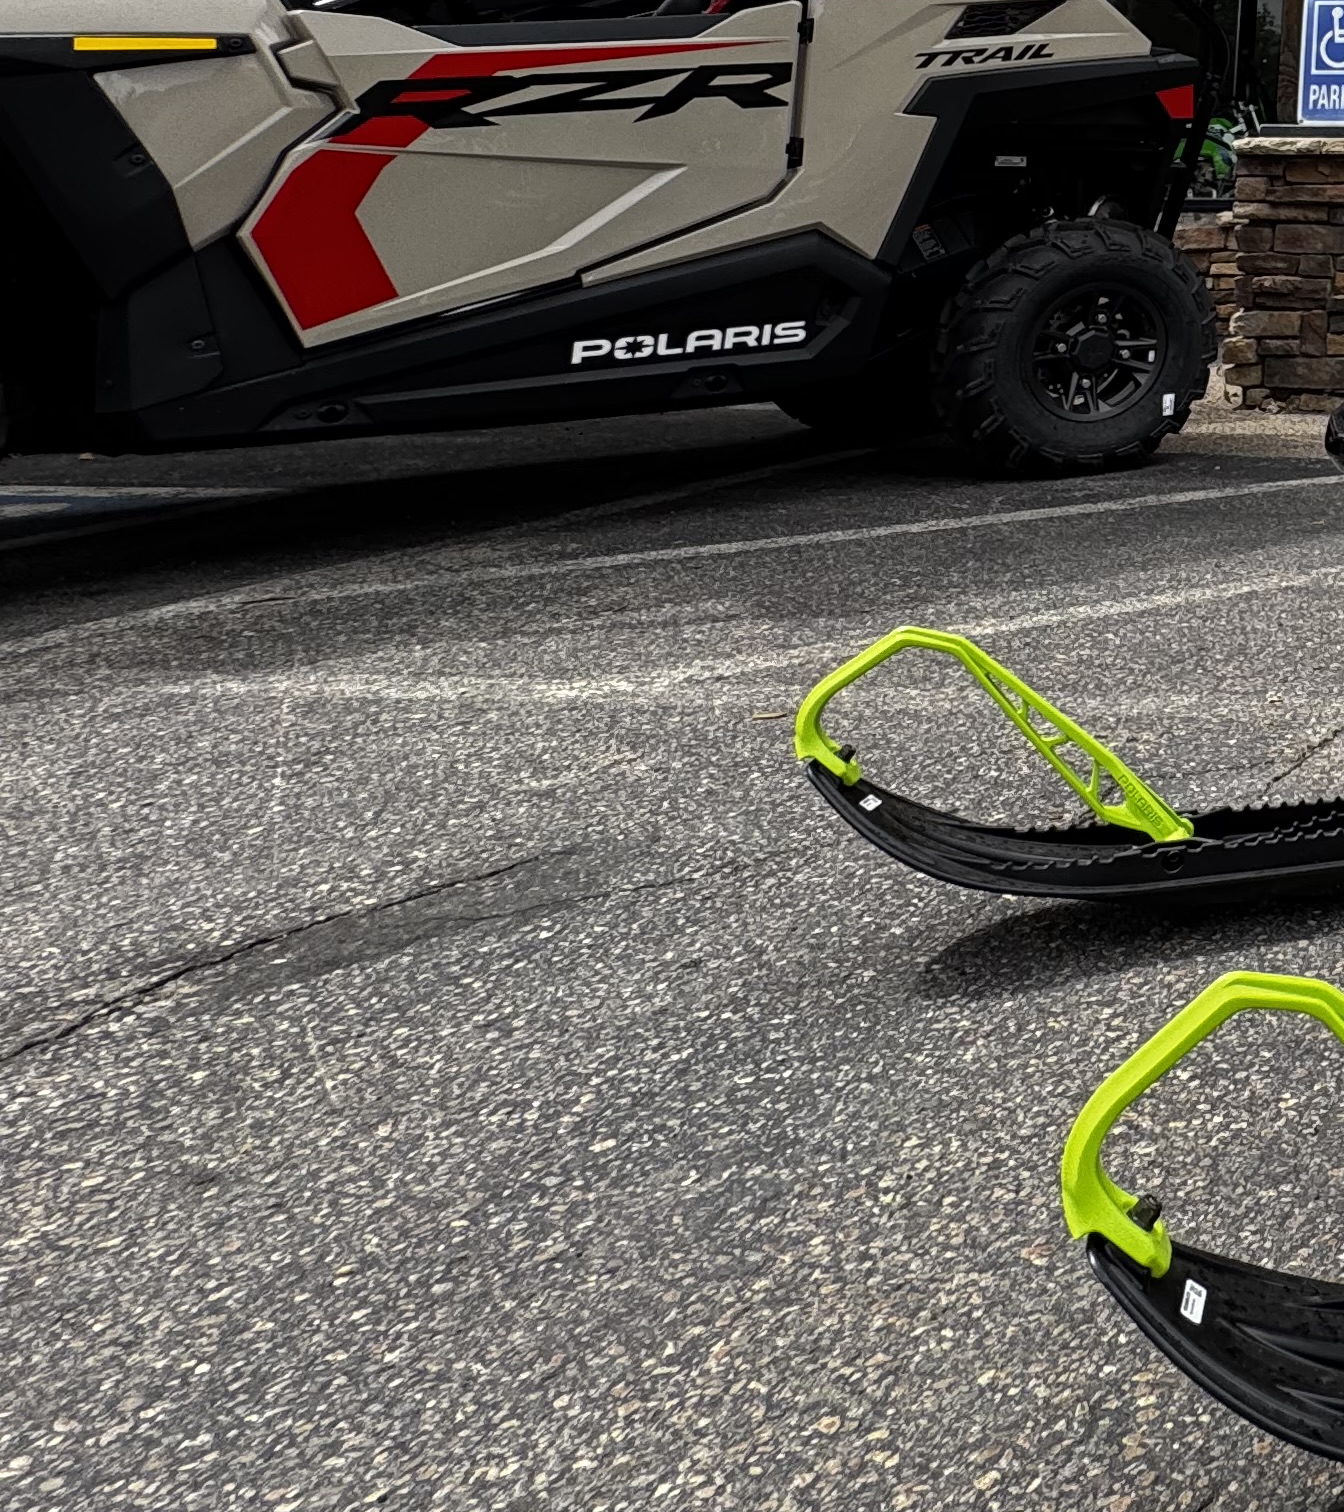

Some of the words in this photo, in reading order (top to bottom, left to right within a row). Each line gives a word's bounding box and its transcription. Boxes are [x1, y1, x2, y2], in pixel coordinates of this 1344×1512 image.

[914, 43, 1055, 69] TRAIL
[312, 62, 794, 142] RZR
[570, 320, 807, 364] POLARIS
